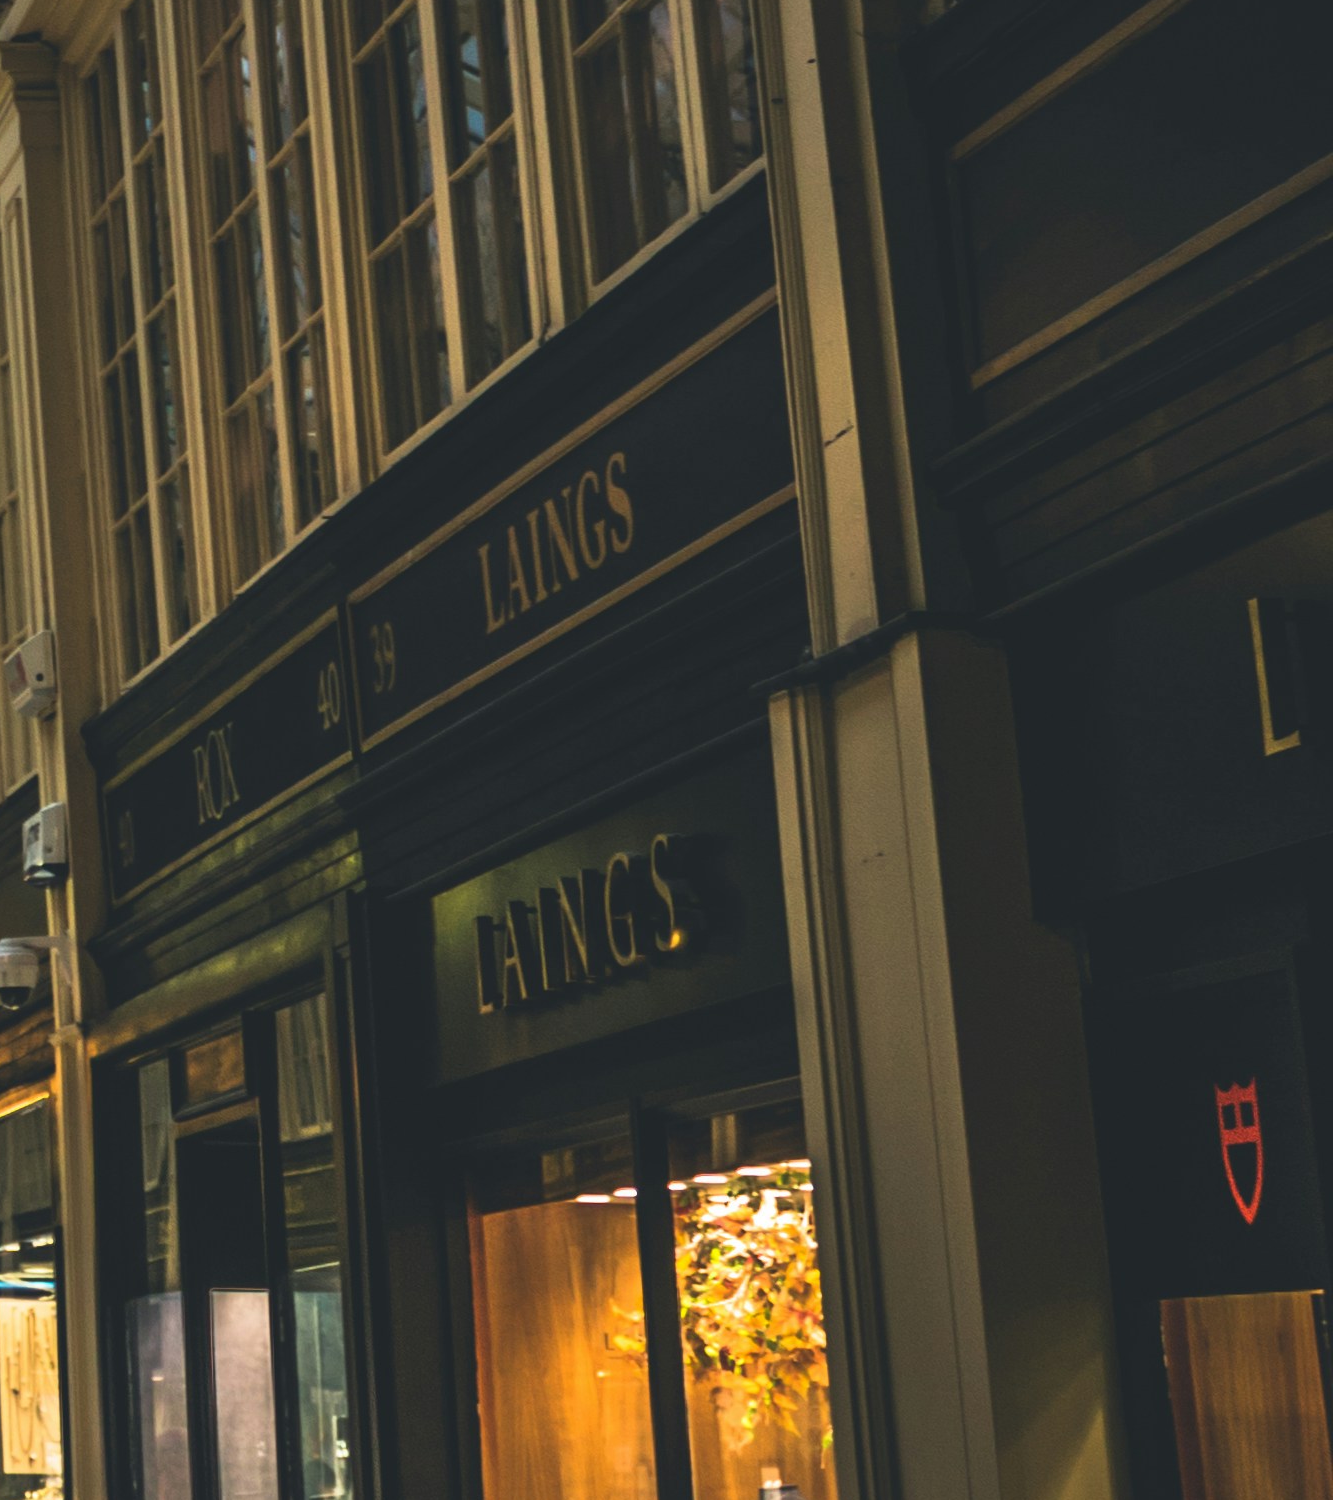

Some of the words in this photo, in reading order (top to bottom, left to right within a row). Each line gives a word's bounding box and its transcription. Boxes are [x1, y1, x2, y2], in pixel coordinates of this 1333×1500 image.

[475, 451, 636, 635] LAINGS
[193, 720, 241, 826] ROX
[315, 657, 343, 733] 40
[369, 619, 397, 694] 39
[475, 833, 686, 1016] LAINGS
